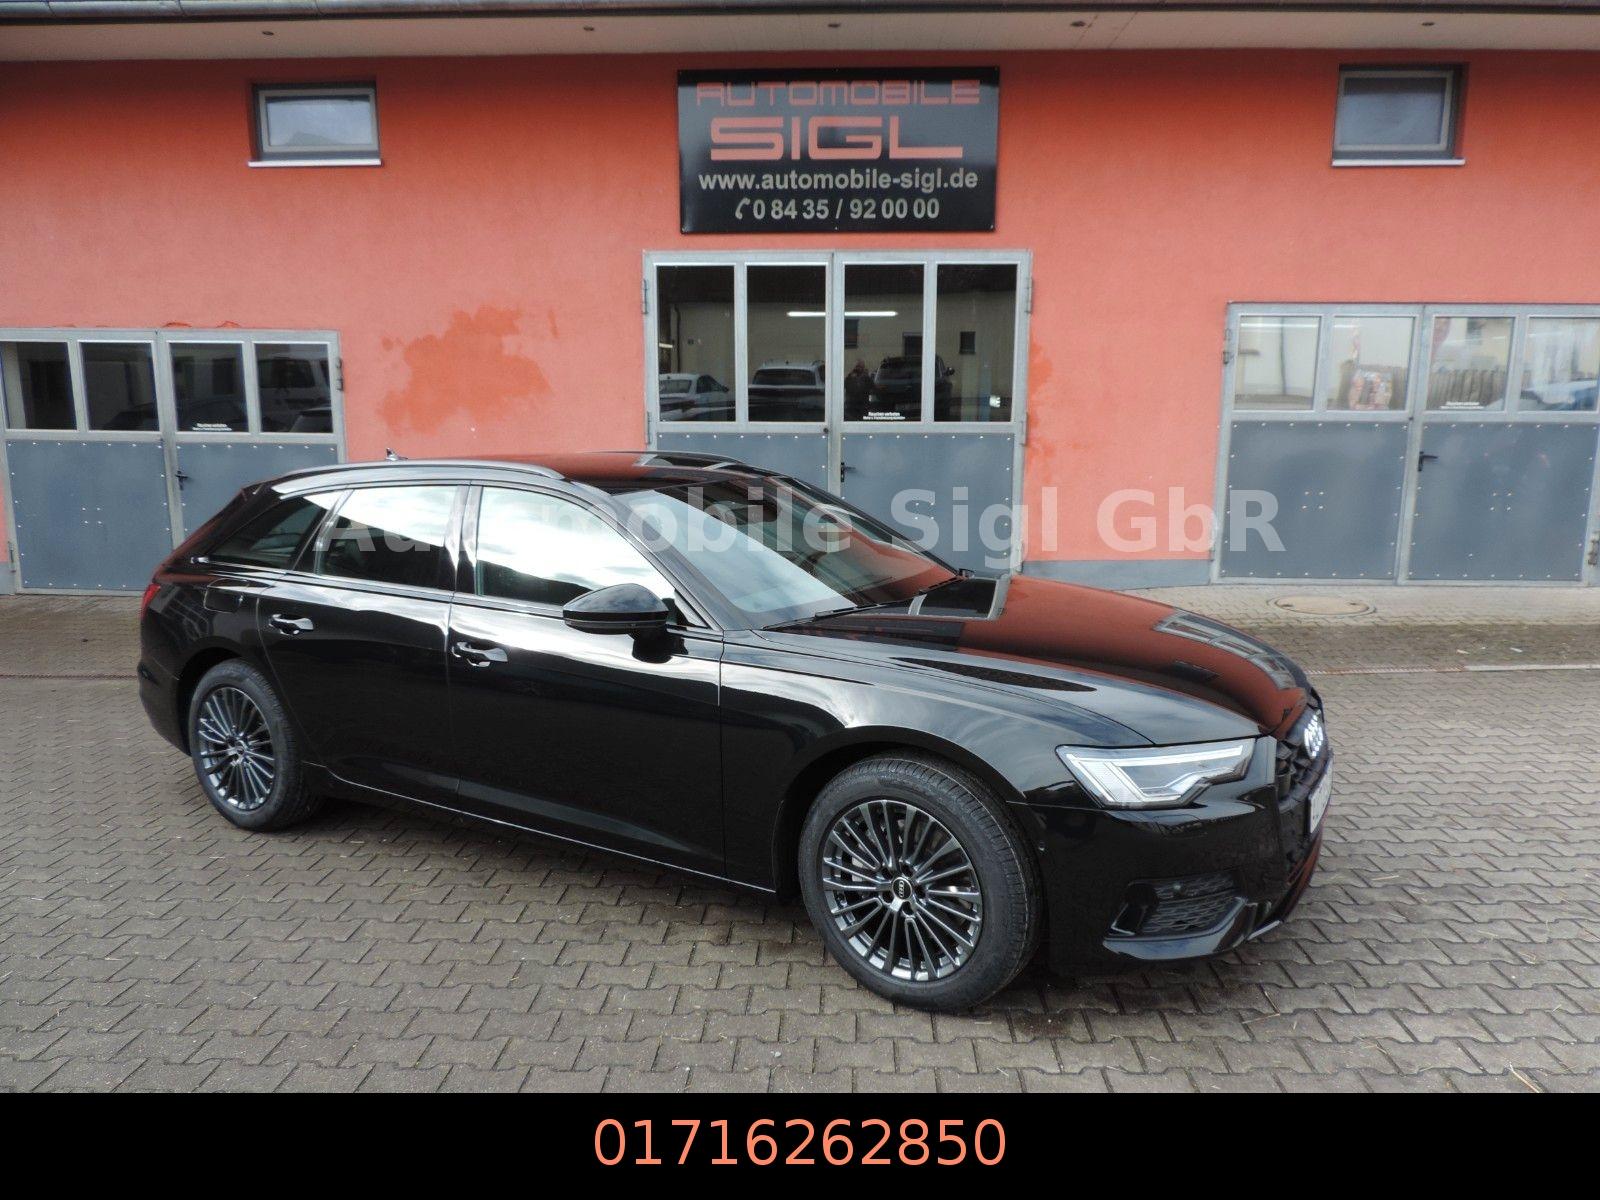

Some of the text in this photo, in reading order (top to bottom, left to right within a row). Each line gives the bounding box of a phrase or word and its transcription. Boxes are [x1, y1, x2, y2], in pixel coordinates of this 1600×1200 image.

[696, 79, 981, 107] AUTOMOBILE
[710, 115, 964, 161] SIGL
[698, 167, 979, 193] www.automobile-sigl.de
[770, 199, 798, 219] 84
[802, 199, 830, 219] 35
[849, 199, 877, 219] 92
[881, 198, 908, 219] 00
[913, 198, 940, 219] 00
